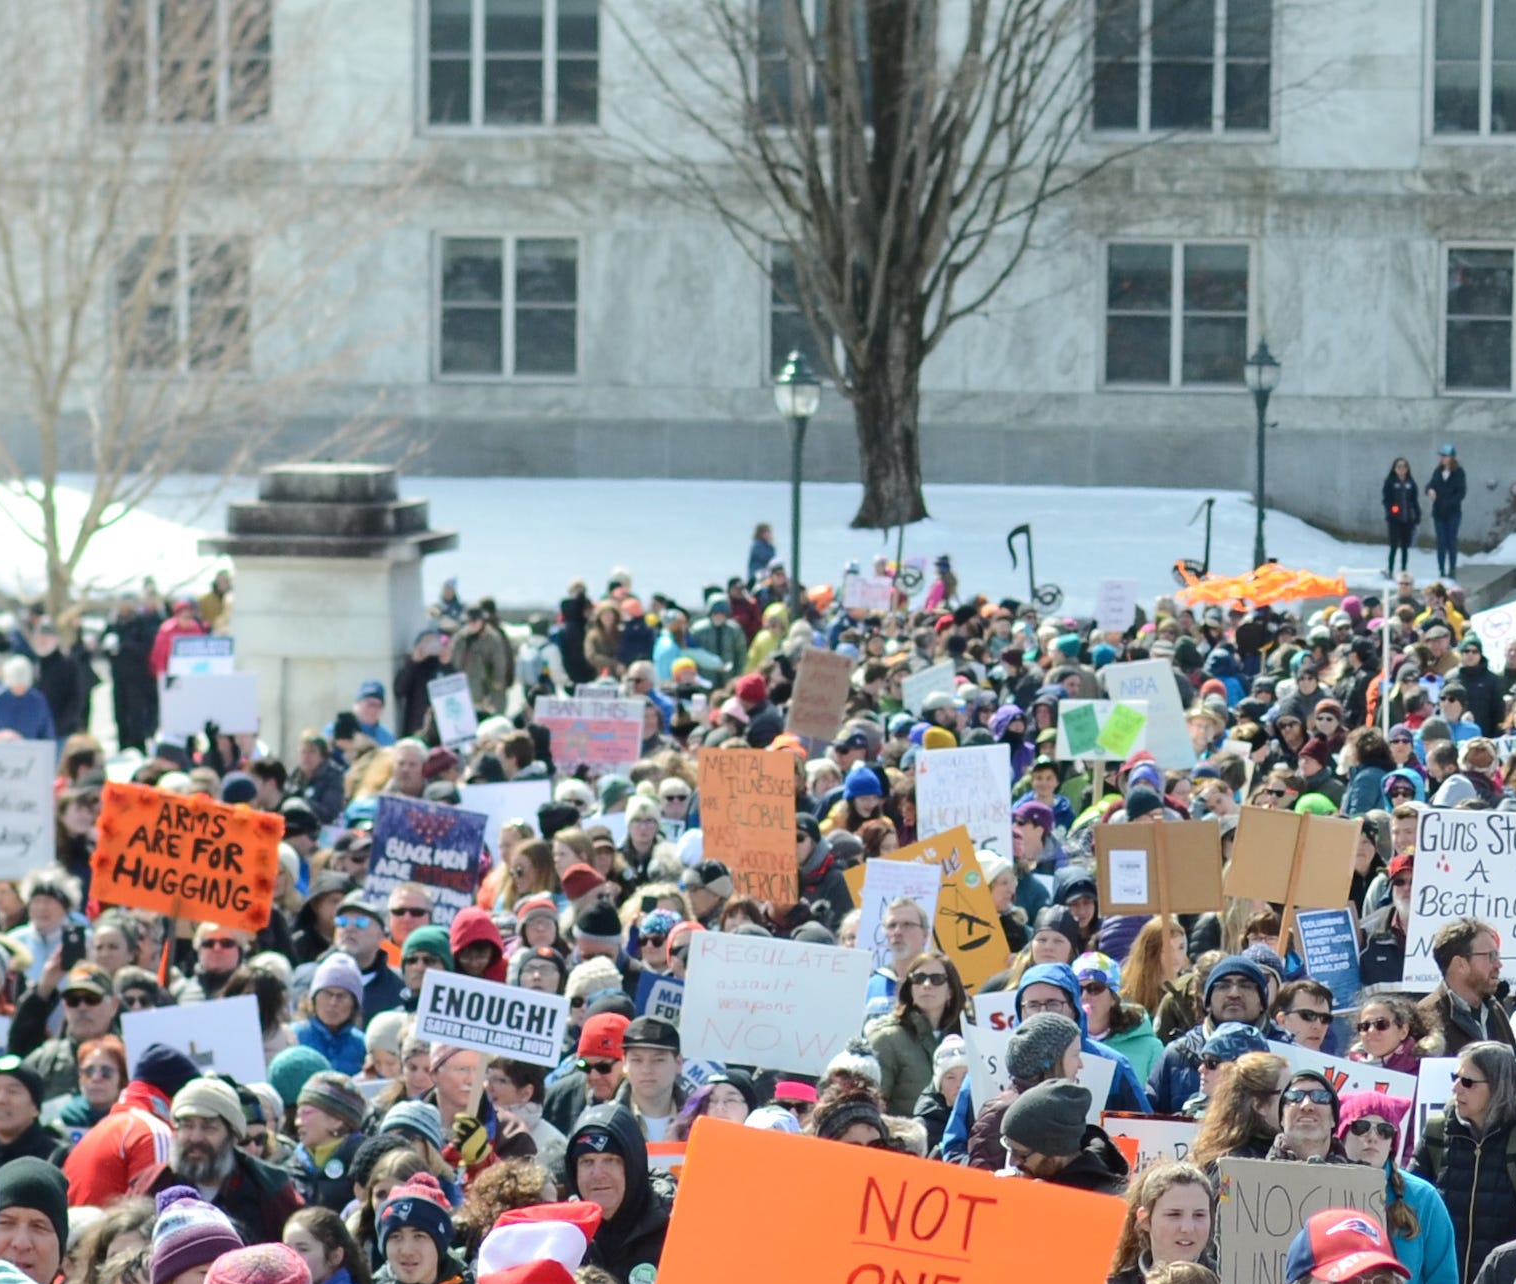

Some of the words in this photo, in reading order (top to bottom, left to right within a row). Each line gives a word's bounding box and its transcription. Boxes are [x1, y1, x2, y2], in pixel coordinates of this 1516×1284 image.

[1119, 677, 1159, 696] NRA
[549, 703, 582, 717] BAN
[593, 702, 628, 718] THIS
[704, 754, 766, 781] MENTAL
[725, 776, 793, 798] ILLNESSES
[157, 802, 227, 838] ARMS
[725, 802, 791, 830] GLOBAL
[1420, 812, 1477, 852] Guns
[128, 825, 181, 858] ARE
[191, 838, 243, 874] FOR
[385, 836, 433, 867] BLACK
[113, 854, 251, 912] HUGGING
[1465, 859, 1491, 883] A
[701, 938, 850, 973] REGULATE
[717, 978, 798, 992] assault
[429, 984, 558, 1036] ENOUGH!
[718, 998, 798, 1015] weapons
[425, 1018, 461, 1036] SAFER
[462, 1025, 487, 1043] GUN
[489, 1031, 521, 1050] LAWS
[523, 1038, 552, 1057] NOW
[701, 1018, 837, 1058] NOW
[859, 1176, 998, 1253] NOT
[1236, 1181, 1292, 1237] NO
